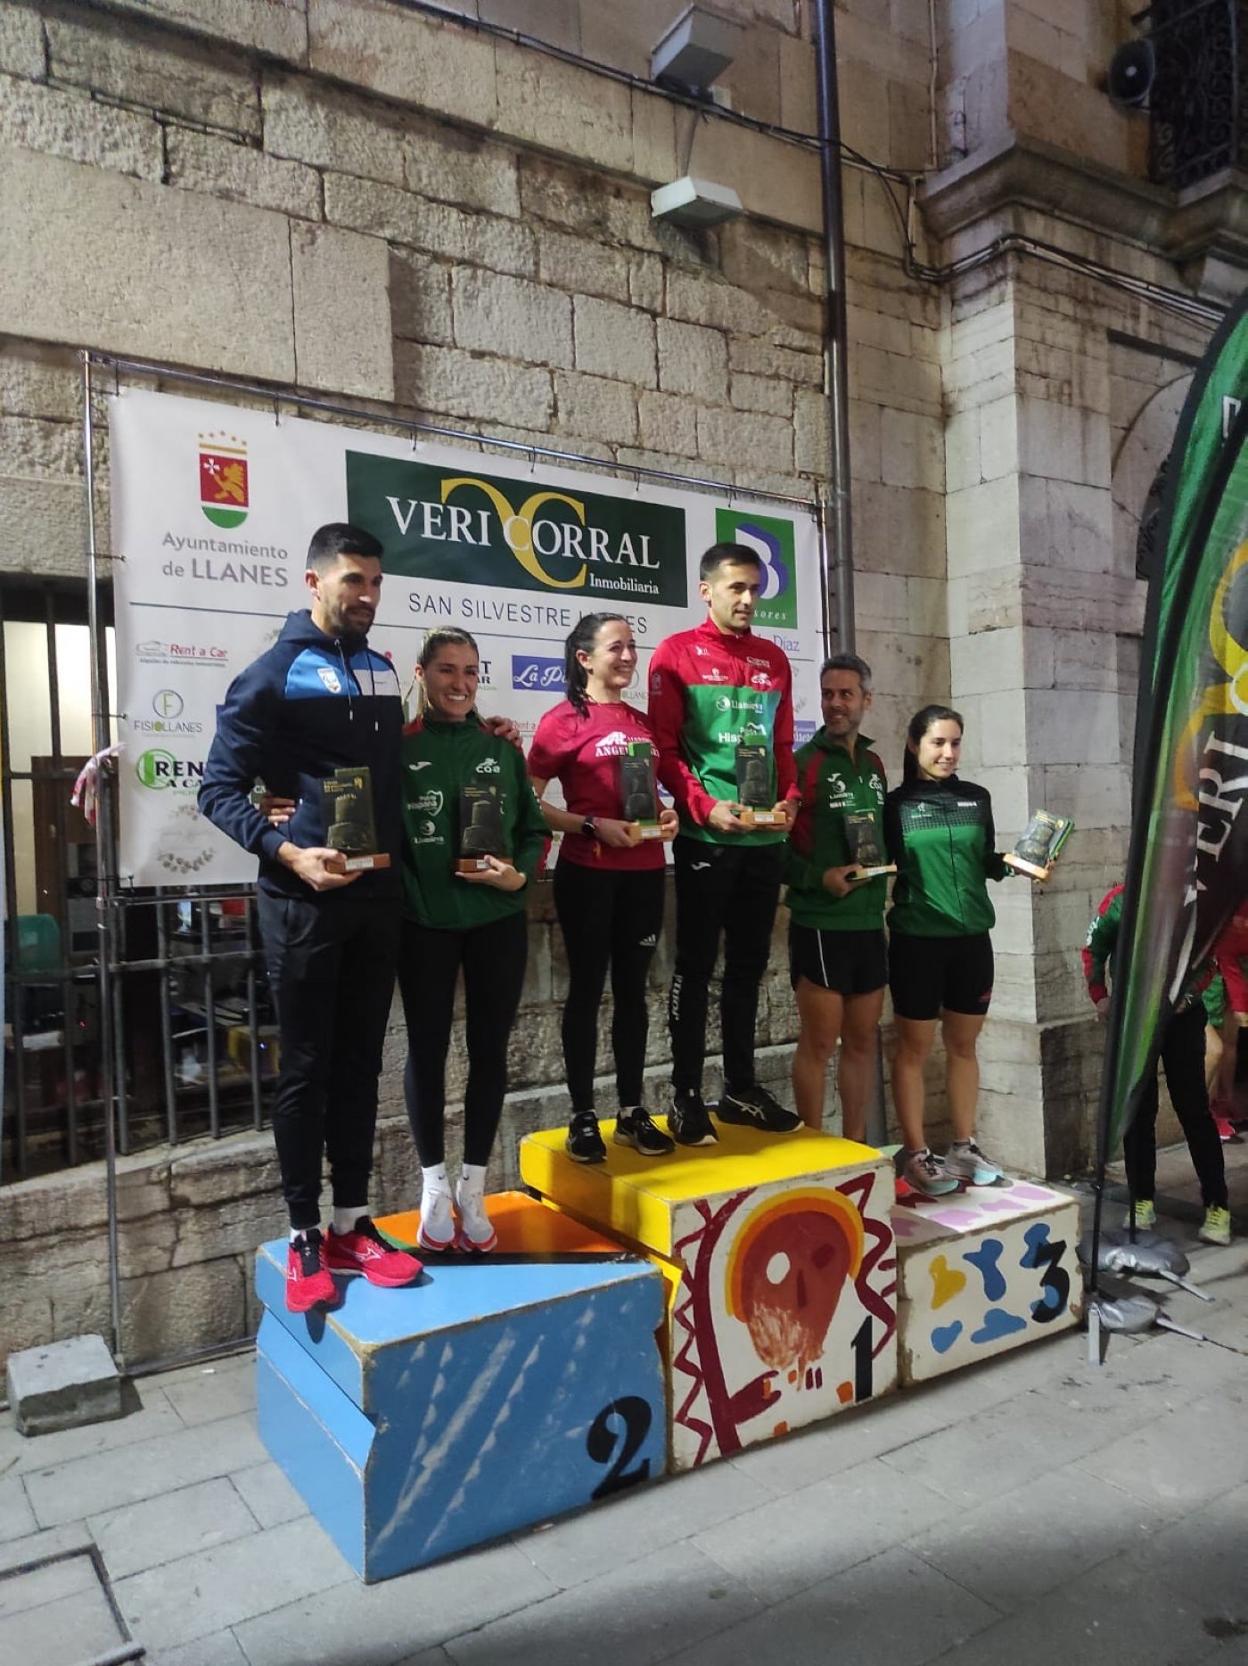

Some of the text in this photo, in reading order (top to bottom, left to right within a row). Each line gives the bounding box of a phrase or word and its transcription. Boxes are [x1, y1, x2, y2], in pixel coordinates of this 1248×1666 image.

[162, 532, 289, 560] Ayuntamiento
[385, 495, 660, 569] VERI CORRAL
[162, 558, 289, 587] de LLANES
[589, 573, 660, 596] Inmobiliaria
[408, 593, 453, 617] SAN
[462, 599, 571, 628] SILVESTRE
[513, 664, 539, 687] La
[155, 760, 204, 777] REN
[1029, 1239, 1071, 1324] 3
[850, 1314, 873, 1402] 1
[585, 1395, 653, 1500] 2
